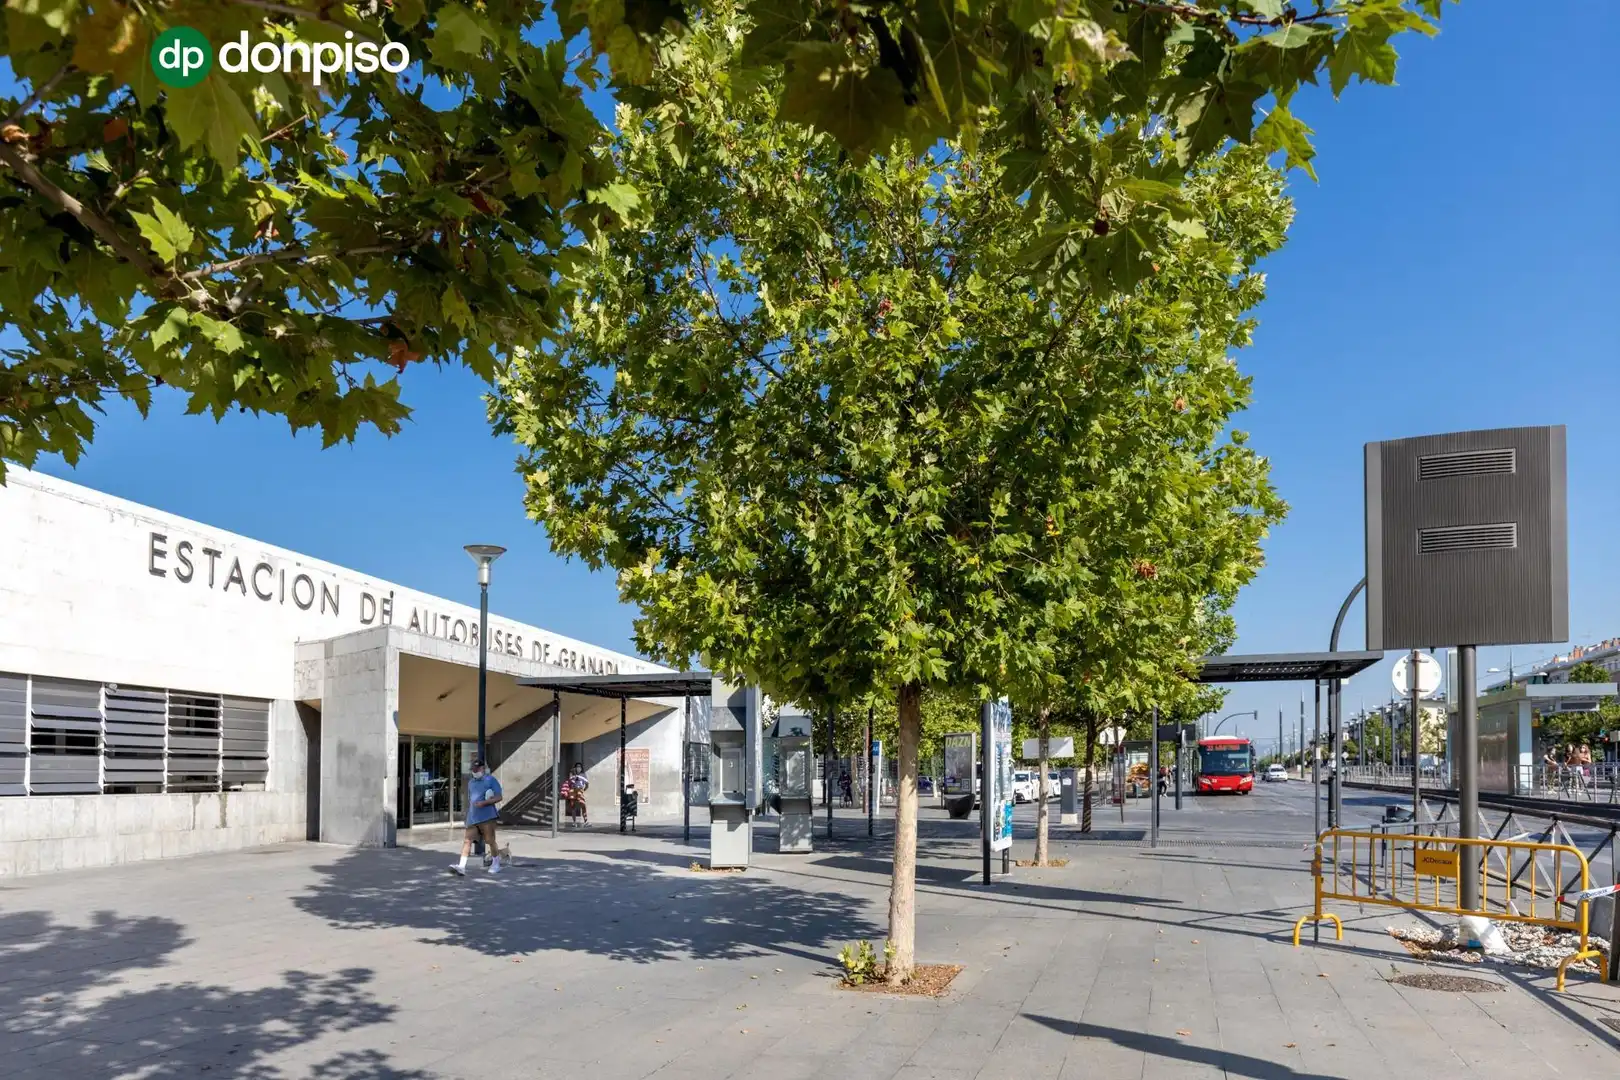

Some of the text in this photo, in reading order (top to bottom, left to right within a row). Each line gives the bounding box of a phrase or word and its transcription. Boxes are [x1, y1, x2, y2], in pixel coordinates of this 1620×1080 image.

[148, 531, 340, 618] ESTACION
[359, 591, 392, 625] DE
[531, 639, 550, 663] DE
[945, 736, 971, 748] DAZN
